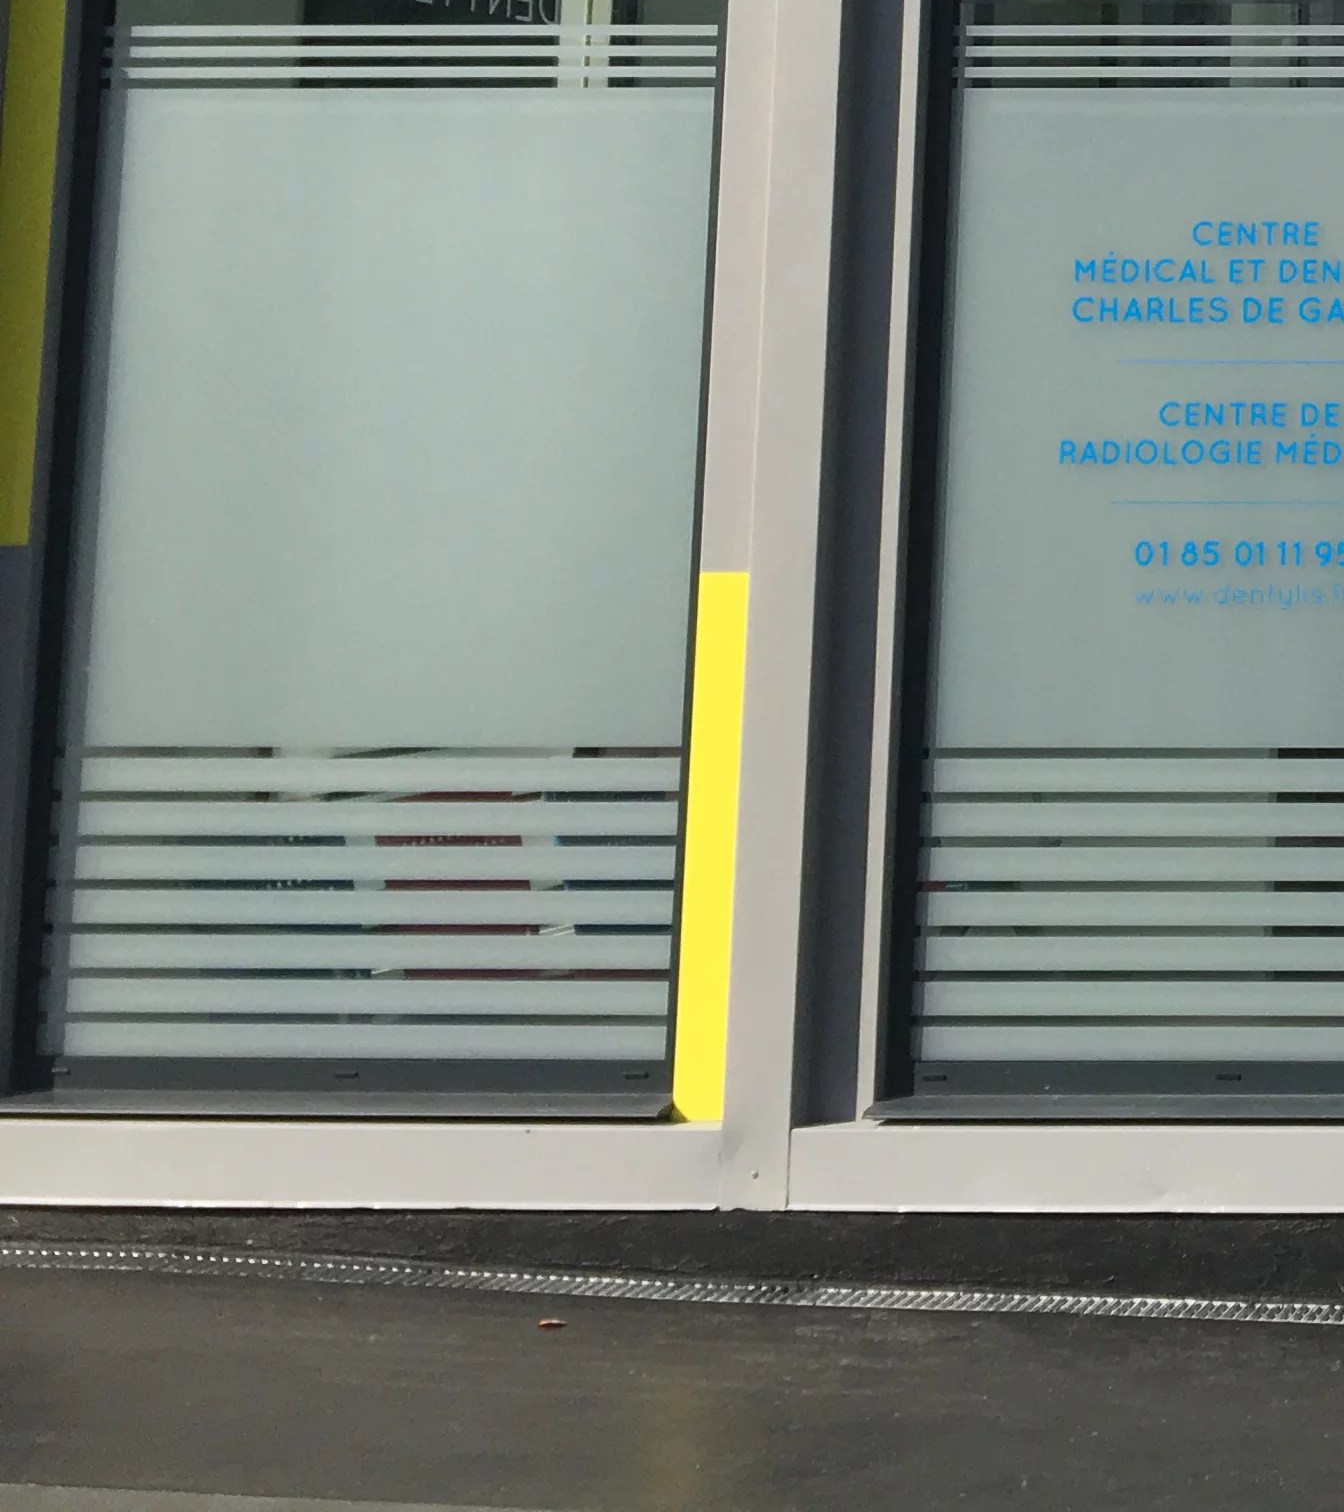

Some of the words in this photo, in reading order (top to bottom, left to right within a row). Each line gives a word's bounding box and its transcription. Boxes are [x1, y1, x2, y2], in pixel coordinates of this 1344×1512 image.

[1191, 220, 1321, 247] CENTRE
[1074, 252, 1216, 285] MÉDICAL
[1228, 258, 1266, 285] ET
[1071, 296, 1229, 324] CHARLES
[1242, 296, 1285, 324] DE
[1158, 401, 1289, 429] CENTRE
[1301, 401, 1342, 429] DE
[1058, 439, 1263, 466] RADIOLOGIE
[1134, 540, 1170, 567] 01
[1180, 540, 1222, 568] 85
[1234, 540, 1266, 568] 01
